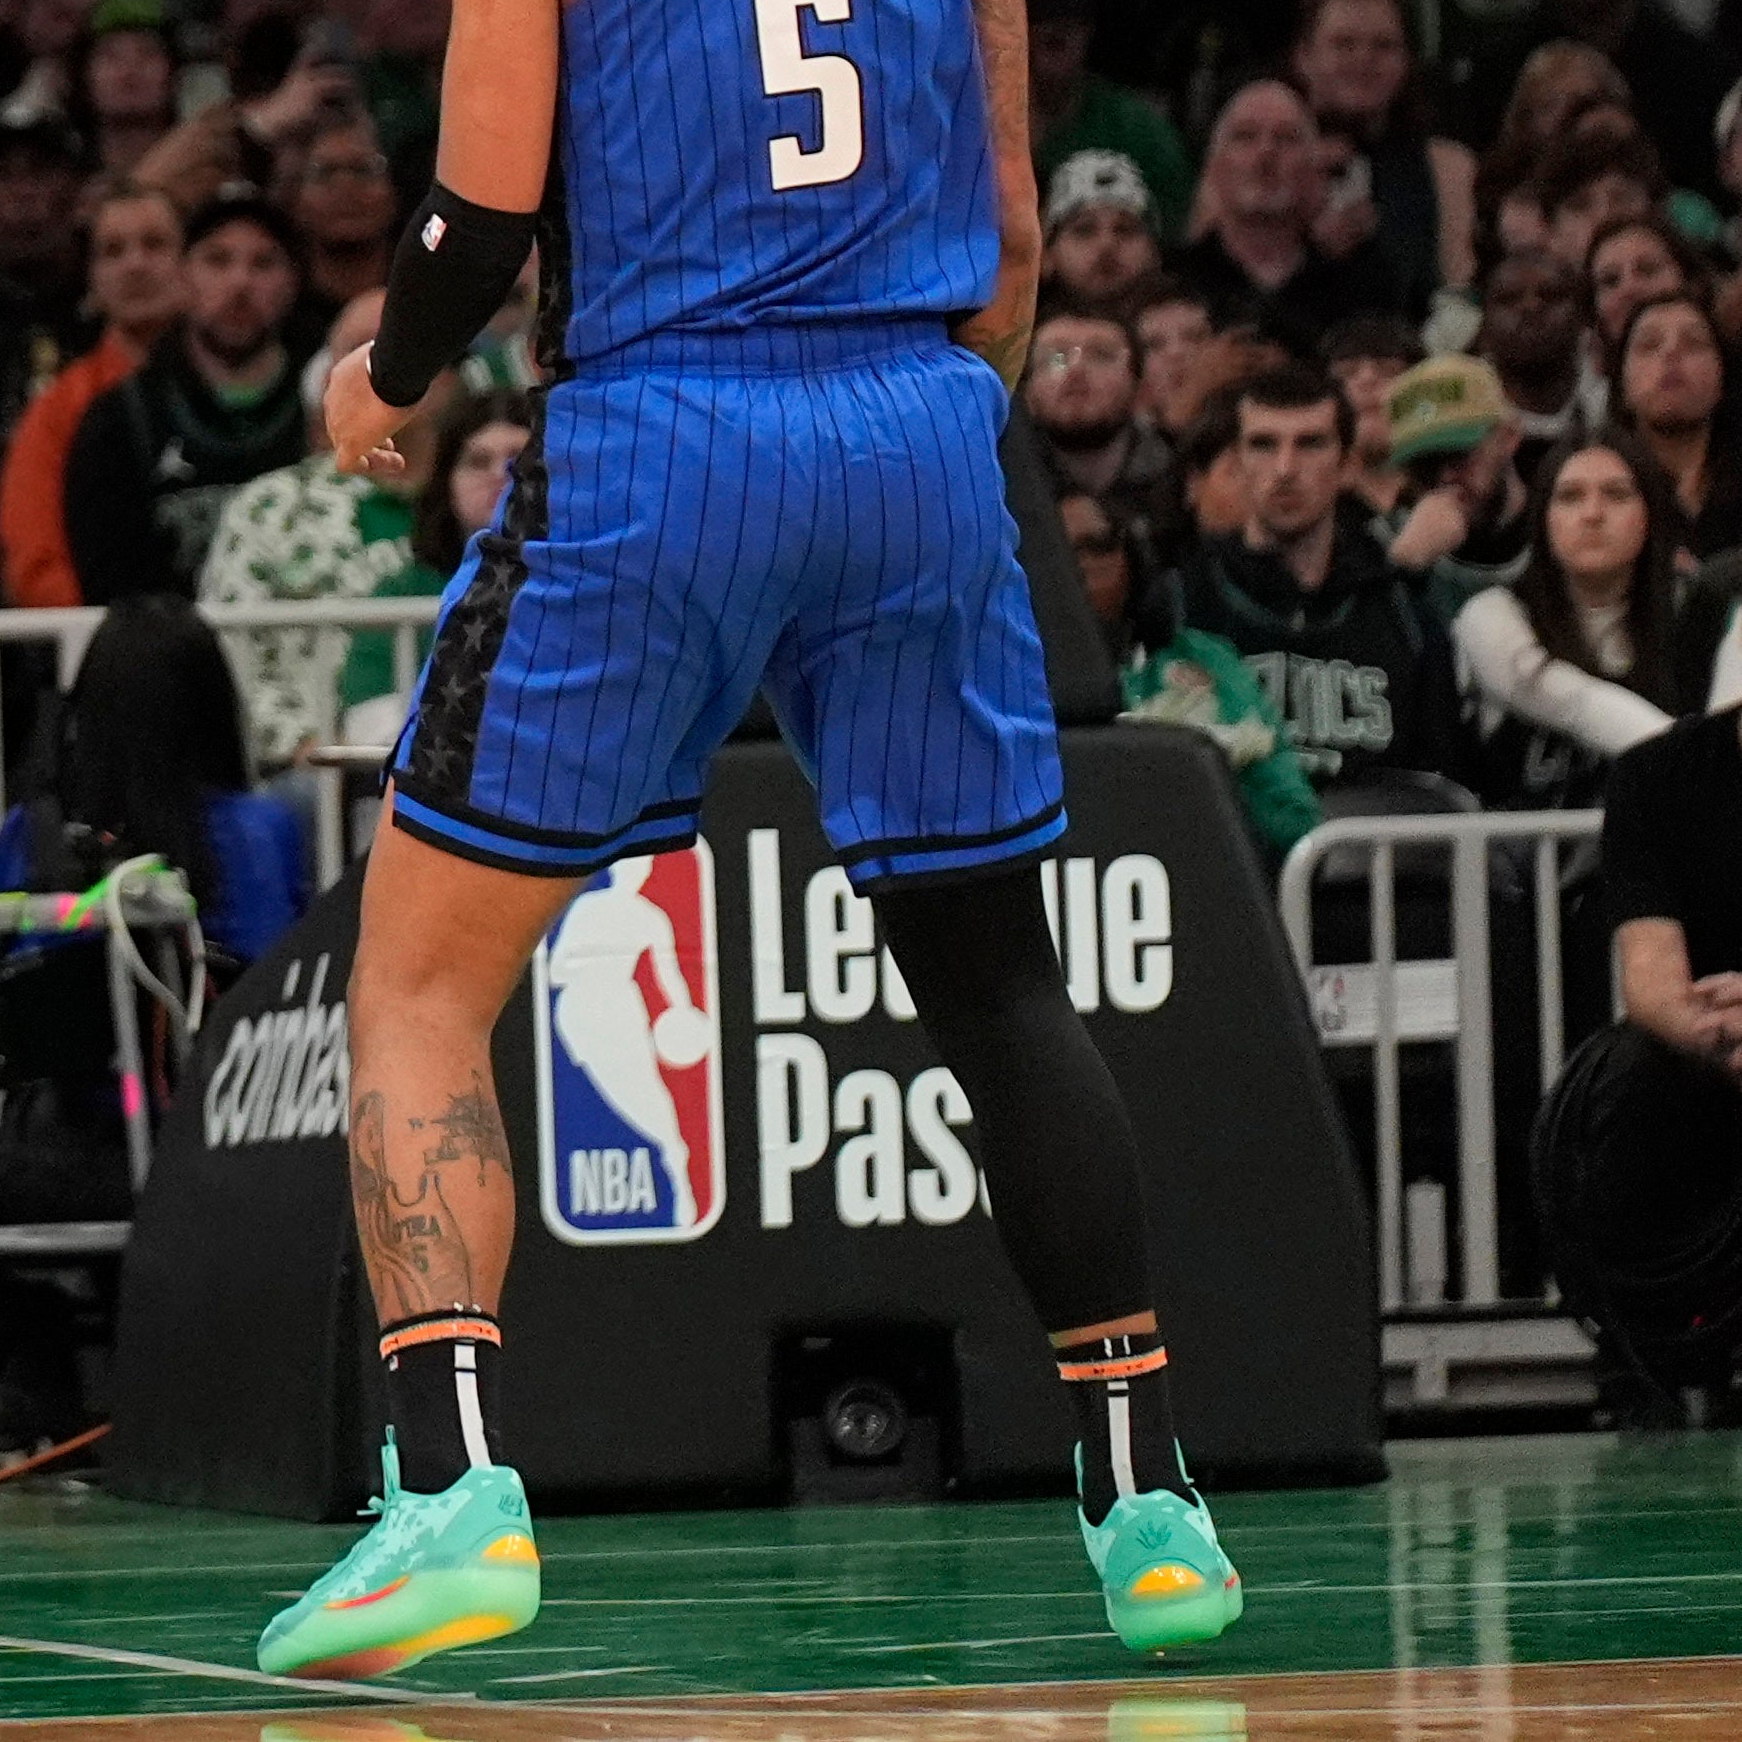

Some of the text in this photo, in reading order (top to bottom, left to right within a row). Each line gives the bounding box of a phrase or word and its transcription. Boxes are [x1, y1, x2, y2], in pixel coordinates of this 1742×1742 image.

[747, 828, 1174, 1026] Leue
[569, 1146, 658, 1216] NBA
[756, 1031, 994, 1230] Pas
